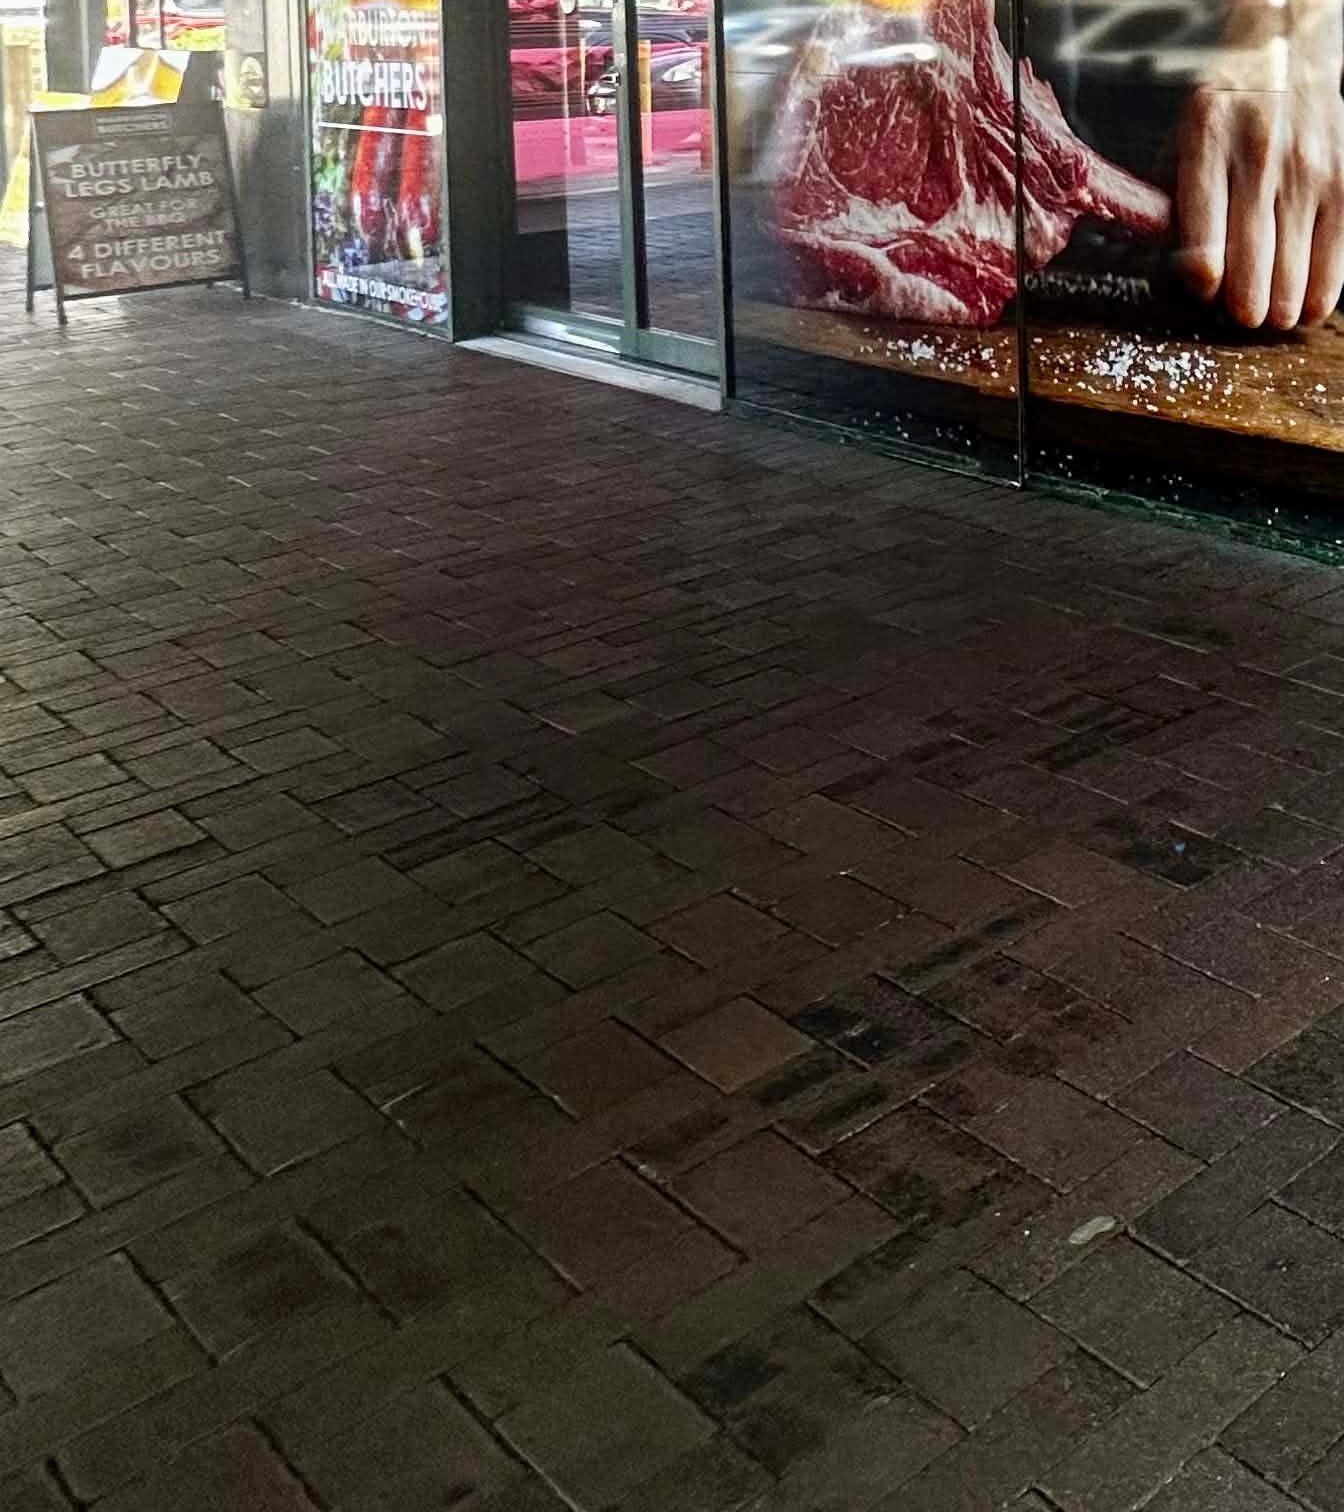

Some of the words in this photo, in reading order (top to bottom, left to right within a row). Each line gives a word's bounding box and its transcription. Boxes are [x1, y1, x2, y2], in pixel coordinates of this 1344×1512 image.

[321, 59, 429, 111] BUTCHERS
[71, 154, 202, 179] BUTTERFLY
[64, 177, 134, 198] LEGS
[142, 171, 215, 191] LAMB
[89, 201, 154, 219] GREAT
[66, 244, 86, 260] 4
[94, 231, 226, 259] DIFFERENT
[81, 249, 222, 279] FLAVOURS
